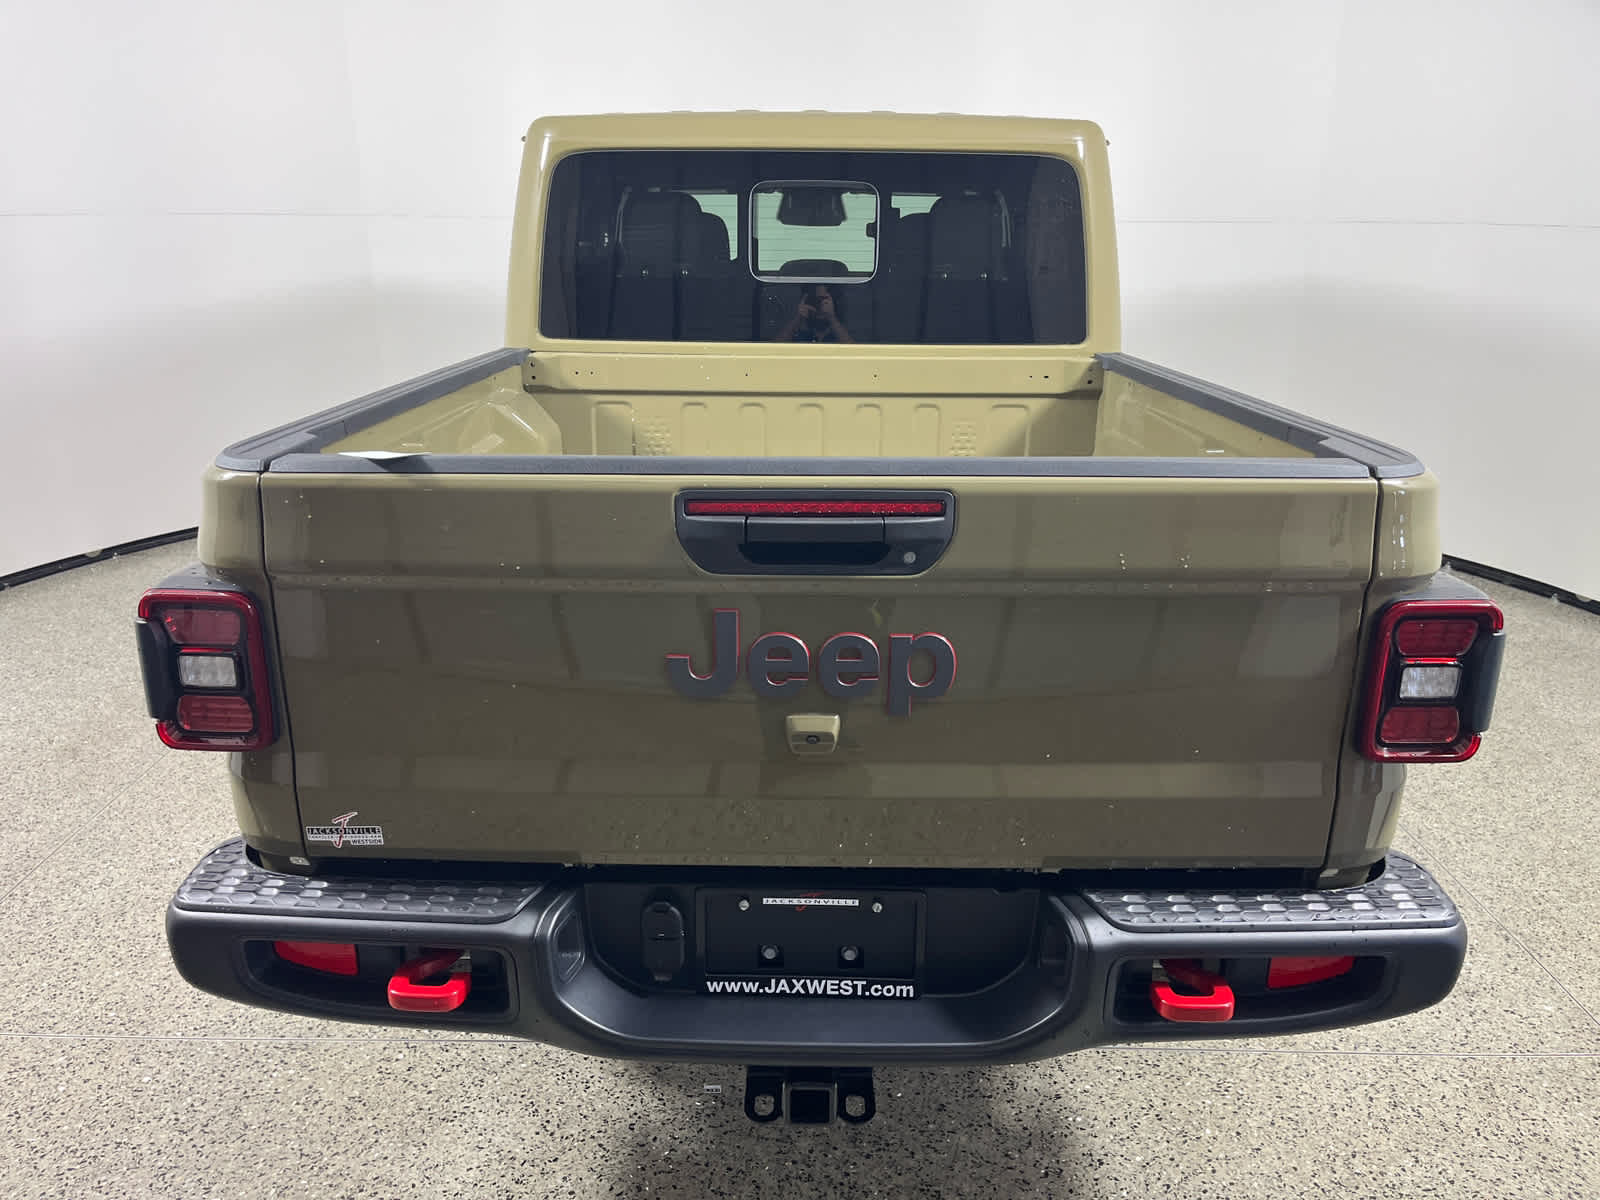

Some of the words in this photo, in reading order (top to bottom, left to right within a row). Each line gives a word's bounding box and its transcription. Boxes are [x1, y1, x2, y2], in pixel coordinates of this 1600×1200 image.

[665, 608, 957, 717] Jeep
[307, 827, 382, 835] JACKSONVILLE
[764, 898, 858, 906] JACKSONVILLE
[706, 978, 915, 998] www.JAXWEST.com
